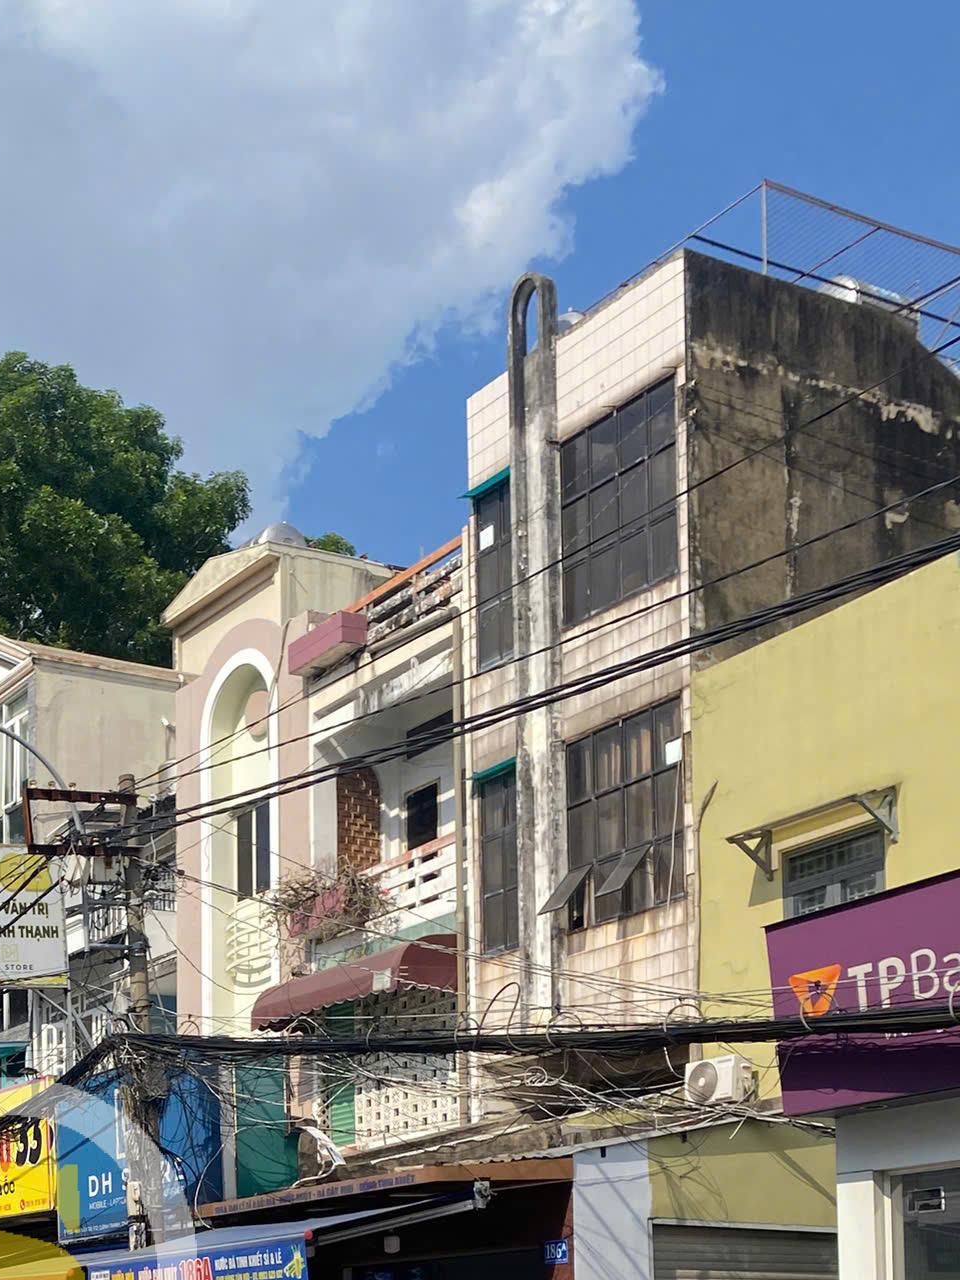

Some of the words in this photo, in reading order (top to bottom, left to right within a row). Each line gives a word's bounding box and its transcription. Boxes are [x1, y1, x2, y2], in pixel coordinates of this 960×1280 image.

[4, 898, 27, 915] VĂN
[18, 925, 59, 942] THẠNH
[15, 1118, 42, 1167] 33
[88, 1172, 113, 1198] DH
